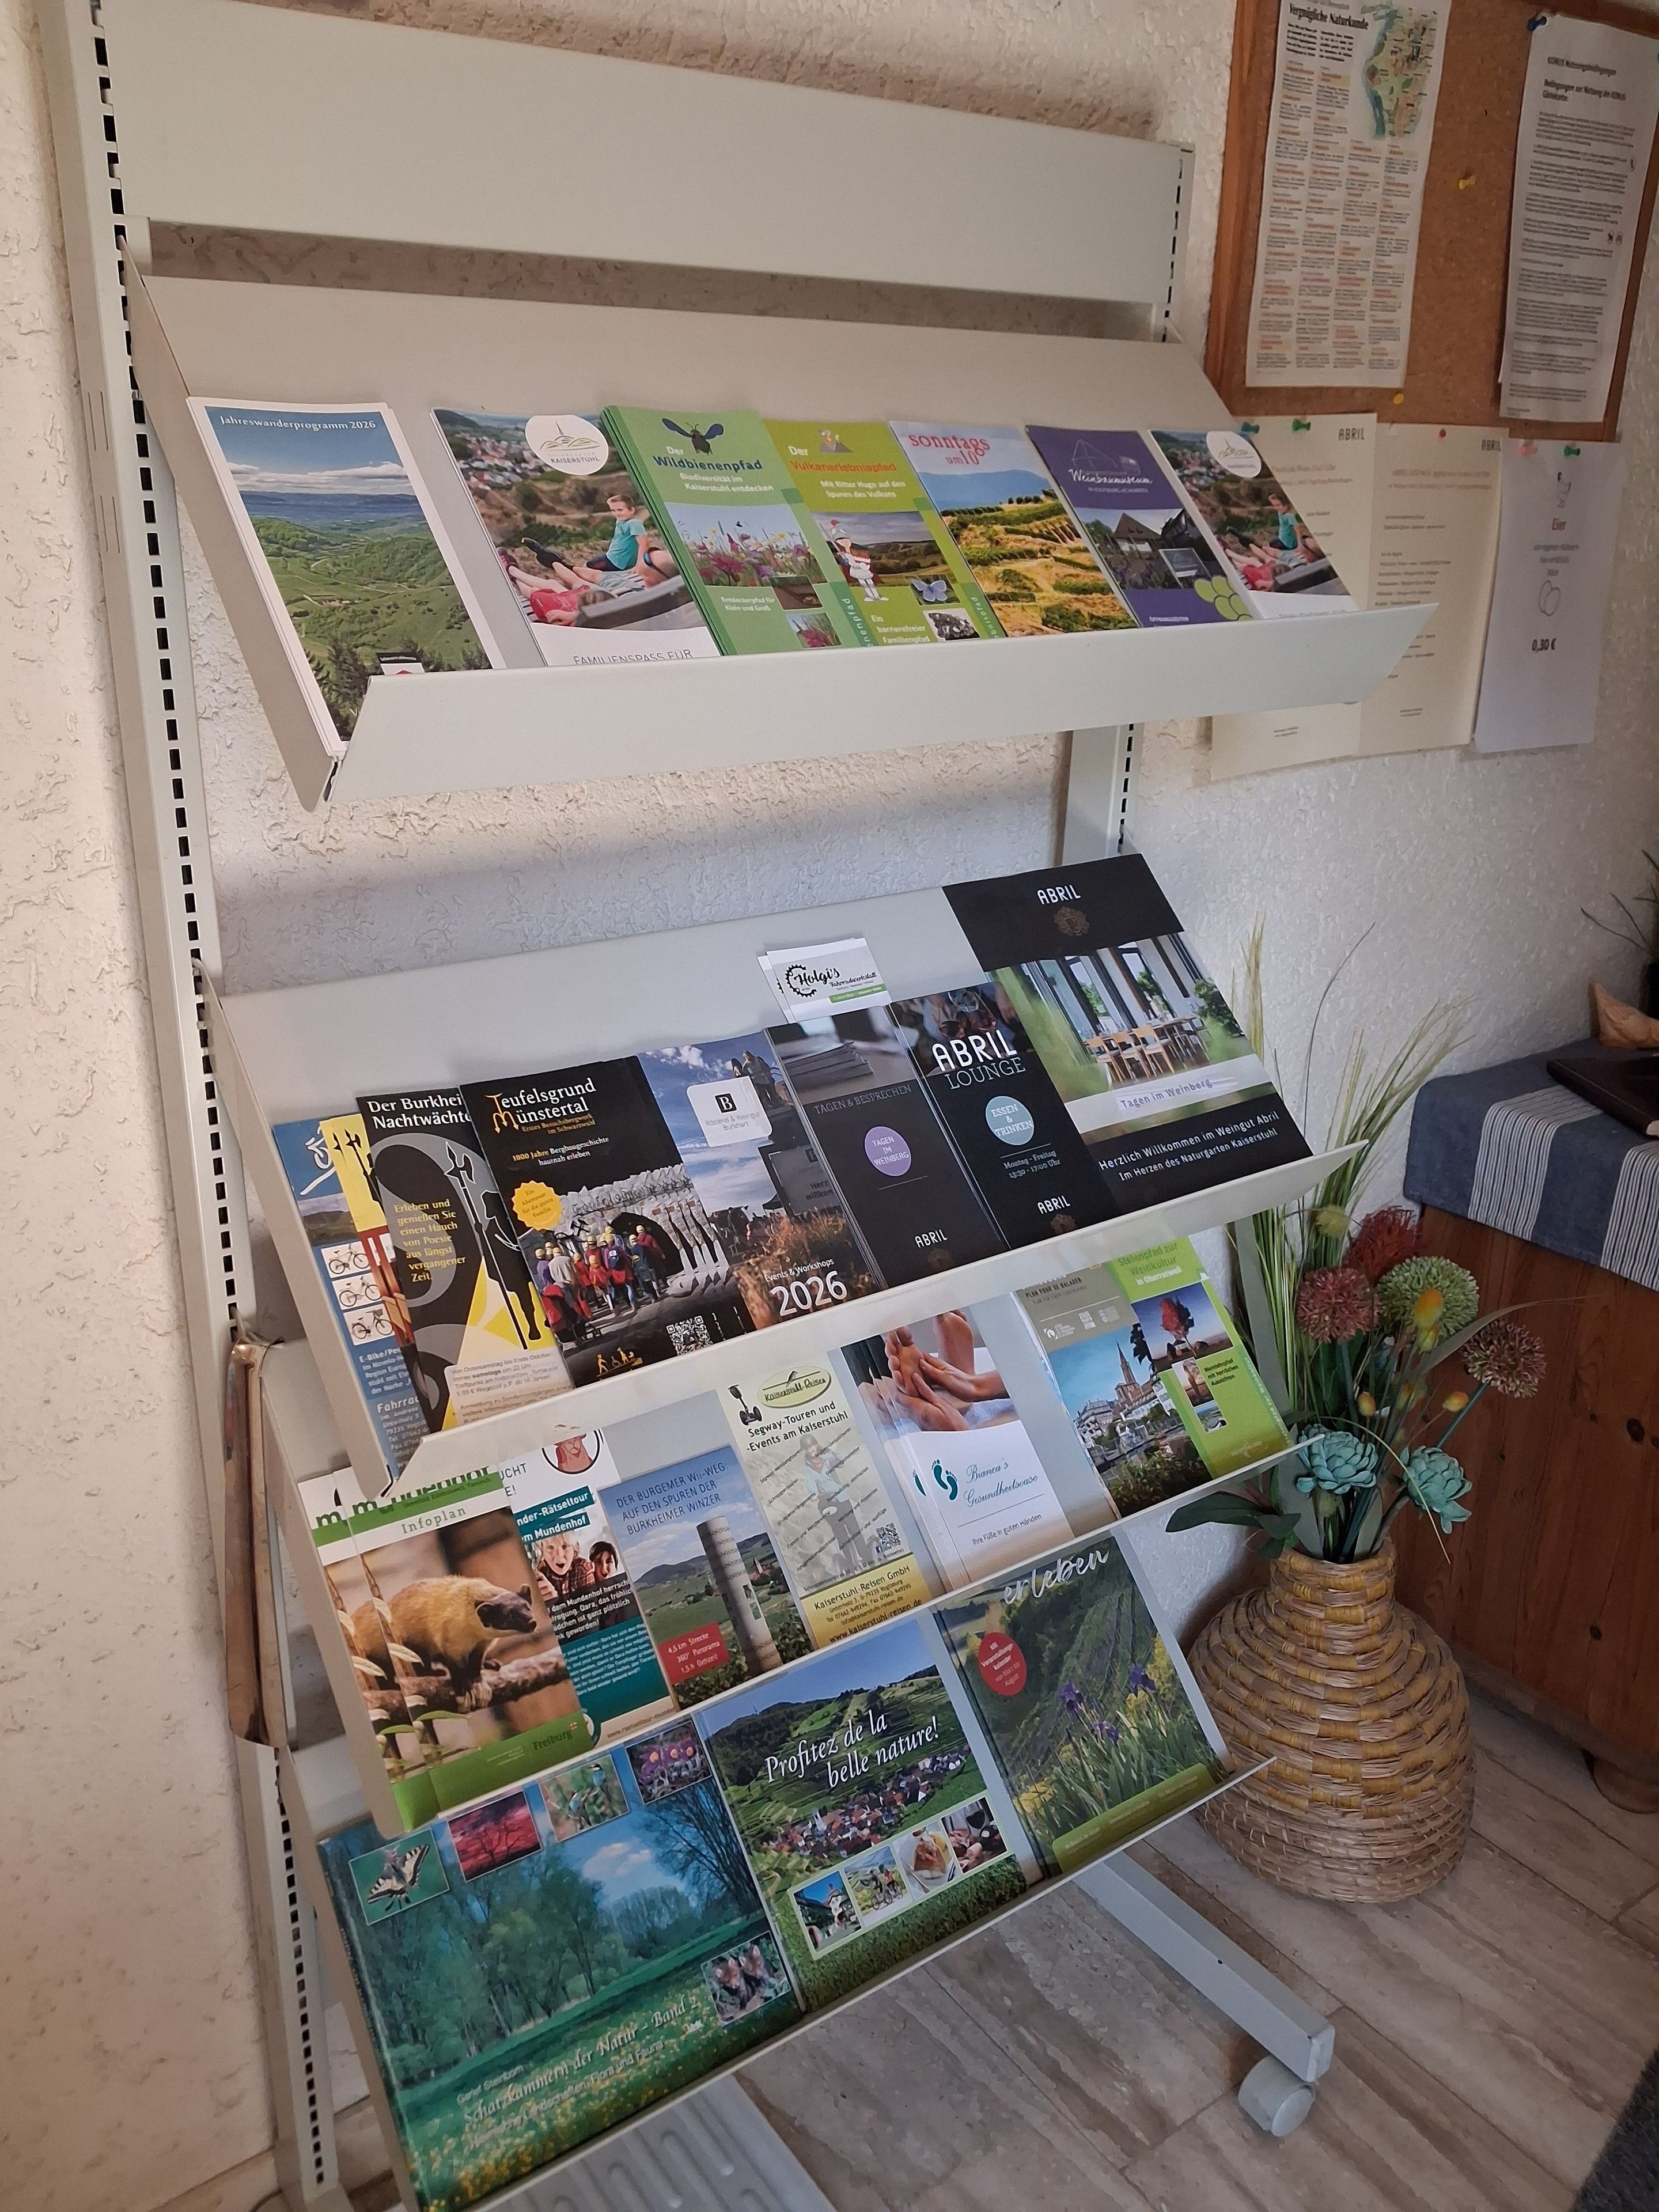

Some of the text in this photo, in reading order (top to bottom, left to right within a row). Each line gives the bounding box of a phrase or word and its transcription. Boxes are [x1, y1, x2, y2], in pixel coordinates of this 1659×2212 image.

[220, 415, 376, 431] Jahreswanderprogramm 2026
[1338, 428, 1365, 441] ABRIL
[666, 446, 684, 455] Der
[788, 446, 808, 456] Der
[908, 435, 990, 456] sonntags
[653, 456, 763, 472] Wildbienenpfad
[790, 460, 897, 473] Vulkanerlebnispfad
[684, 483, 731, 491] Kaiserstuhl
[1037, 884, 1081, 905] ABRIL
[794, 968, 840, 986] Holgi's
[932, 1029, 1017, 1071] ABRIL
[945, 1057, 1027, 1089] LOUNGE
[814, 1100, 846, 1114] TAGEN
[855, 1085, 912, 1105] BESPRECHEN
[1120, 1078, 1213, 1109] Tagen im Weinberg
[367, 1100, 397, 1113] Der
[719, 1096, 733, 1111] B
[991, 1104, 1018, 1118] ESSEN
[995, 1120, 1033, 1137] TRINKEN
[512, 1137, 609, 1161] 1000 Jahre Bergbaugeschichte
[872, 1136, 895, 1146] TAGEN
[1098, 1111, 1279, 1171] Herzlich Willkommen im Weingut Abril
[538, 1150, 590, 1166] hautnah erleben
[874, 1152, 909, 1165] WEINBERG
[1003, 1150, 1056, 1169] Montag Freitag
[1048, 1158, 1060, 1168] Uhr
[1118, 1128, 1278, 1181] Im Herzen des Naturgarten Kaiserstuhl
[394, 1199, 450, 1213] Erleben und
[1037, 1195, 1070, 1214] ABRIL
[397, 1210, 456, 1226] genießen Sie
[400, 1222, 458, 1236] einen Hauch
[915, 1229, 948, 1248] ABRIL
[403, 1234, 452, 1247] von Poesie
[1164, 1242, 1178, 1252] zur
[425, 1247, 453, 1258] längst
[408, 1256, 465, 1271] vergangener
[764, 1270, 788, 1282] Events
[796, 1259, 835, 1275] Workshops
[770, 1271, 847, 1316] 2026
[748, 1401, 836, 1437] Segway-Touren und
[783, 1411, 849, 1440] am Kaiserstuhl
[616, 1476, 686, 1508] DER BURGEMER
[622, 1480, 717, 1521] AUF DEN SPUREN DER
[963, 1475, 1037, 1507] Gesundheitsoase
[400, 1508, 467, 1534] Infoplan
[627, 1493, 721, 1535] BURKHEIMER WINZER
[534, 1516, 586, 1539] Mundenhof
[972, 1537, 983, 1546] Ihre
[983, 1530, 997, 1541] Füße
[1003, 1522, 1019, 1535] guten
[1020, 1514, 1042, 1527] Händen
[1003, 1548, 1110, 1604] erleben
[814, 1577, 885, 1610] Kaiserstuhl-Reisen
[887, 1565, 911, 1580] GmbH
[567, 1589, 603, 1607] Mundenhof
[599, 1597, 610, 1605] das
[587, 1609, 603, 1620] ganz
[604, 1599, 630, 1613] plötzlich
[830, 1598, 922, 1643] www.kaiserstuhl-reisen.de
[692, 1641, 720, 1656] Panorama
[533, 1730, 573, 1751] Freiburg
[765, 1710, 887, 1783] Profitez de la
[827, 1715, 939, 1787] belle nature!
[574, 2048, 593, 2070] der
[597, 2028, 638, 2056] Natur
[652, 1994, 686, 2028] Band
